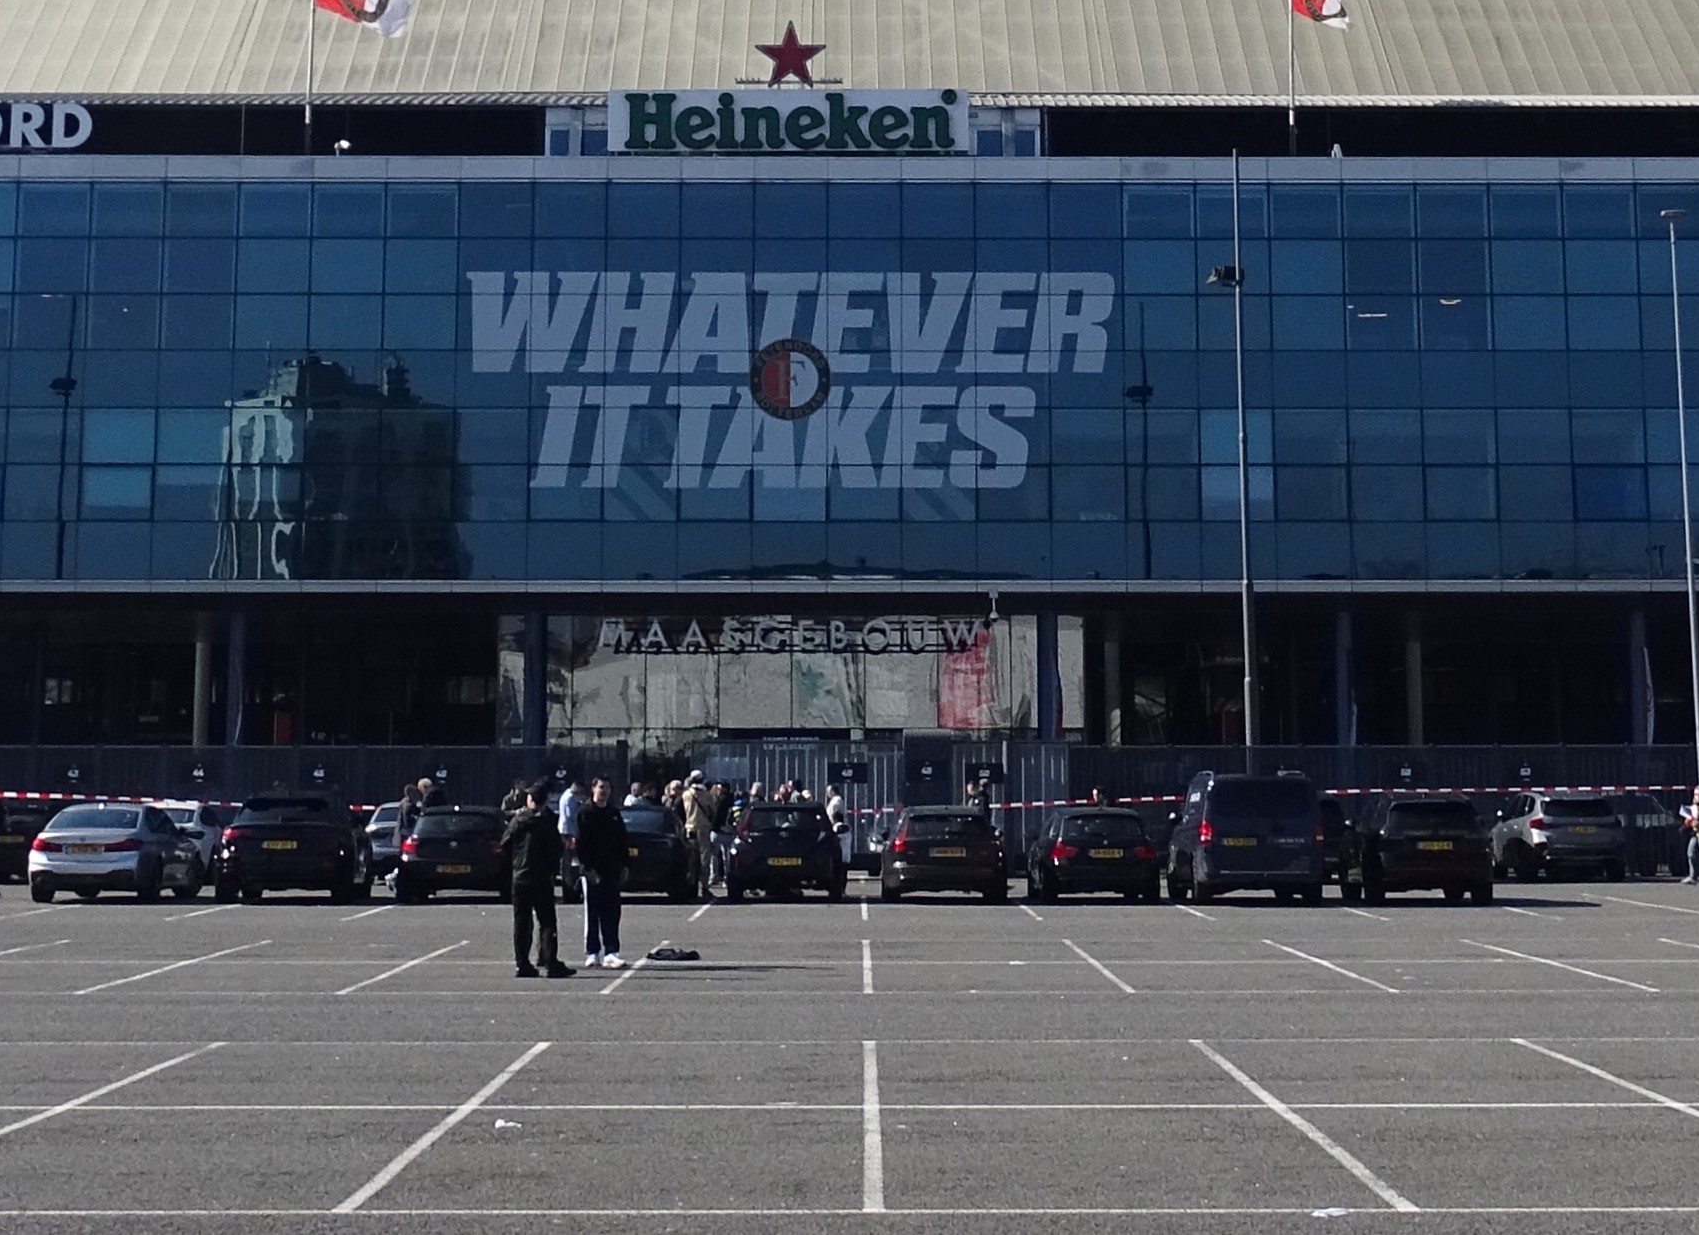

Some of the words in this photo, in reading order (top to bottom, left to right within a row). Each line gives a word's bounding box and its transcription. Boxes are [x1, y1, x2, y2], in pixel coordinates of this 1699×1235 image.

[466, 271, 1115, 373] WHATEVER
[529, 385, 650, 488] IT
[664, 385, 1036, 488] TAKES
[599, 617, 982, 649] MAASGEBOUW
